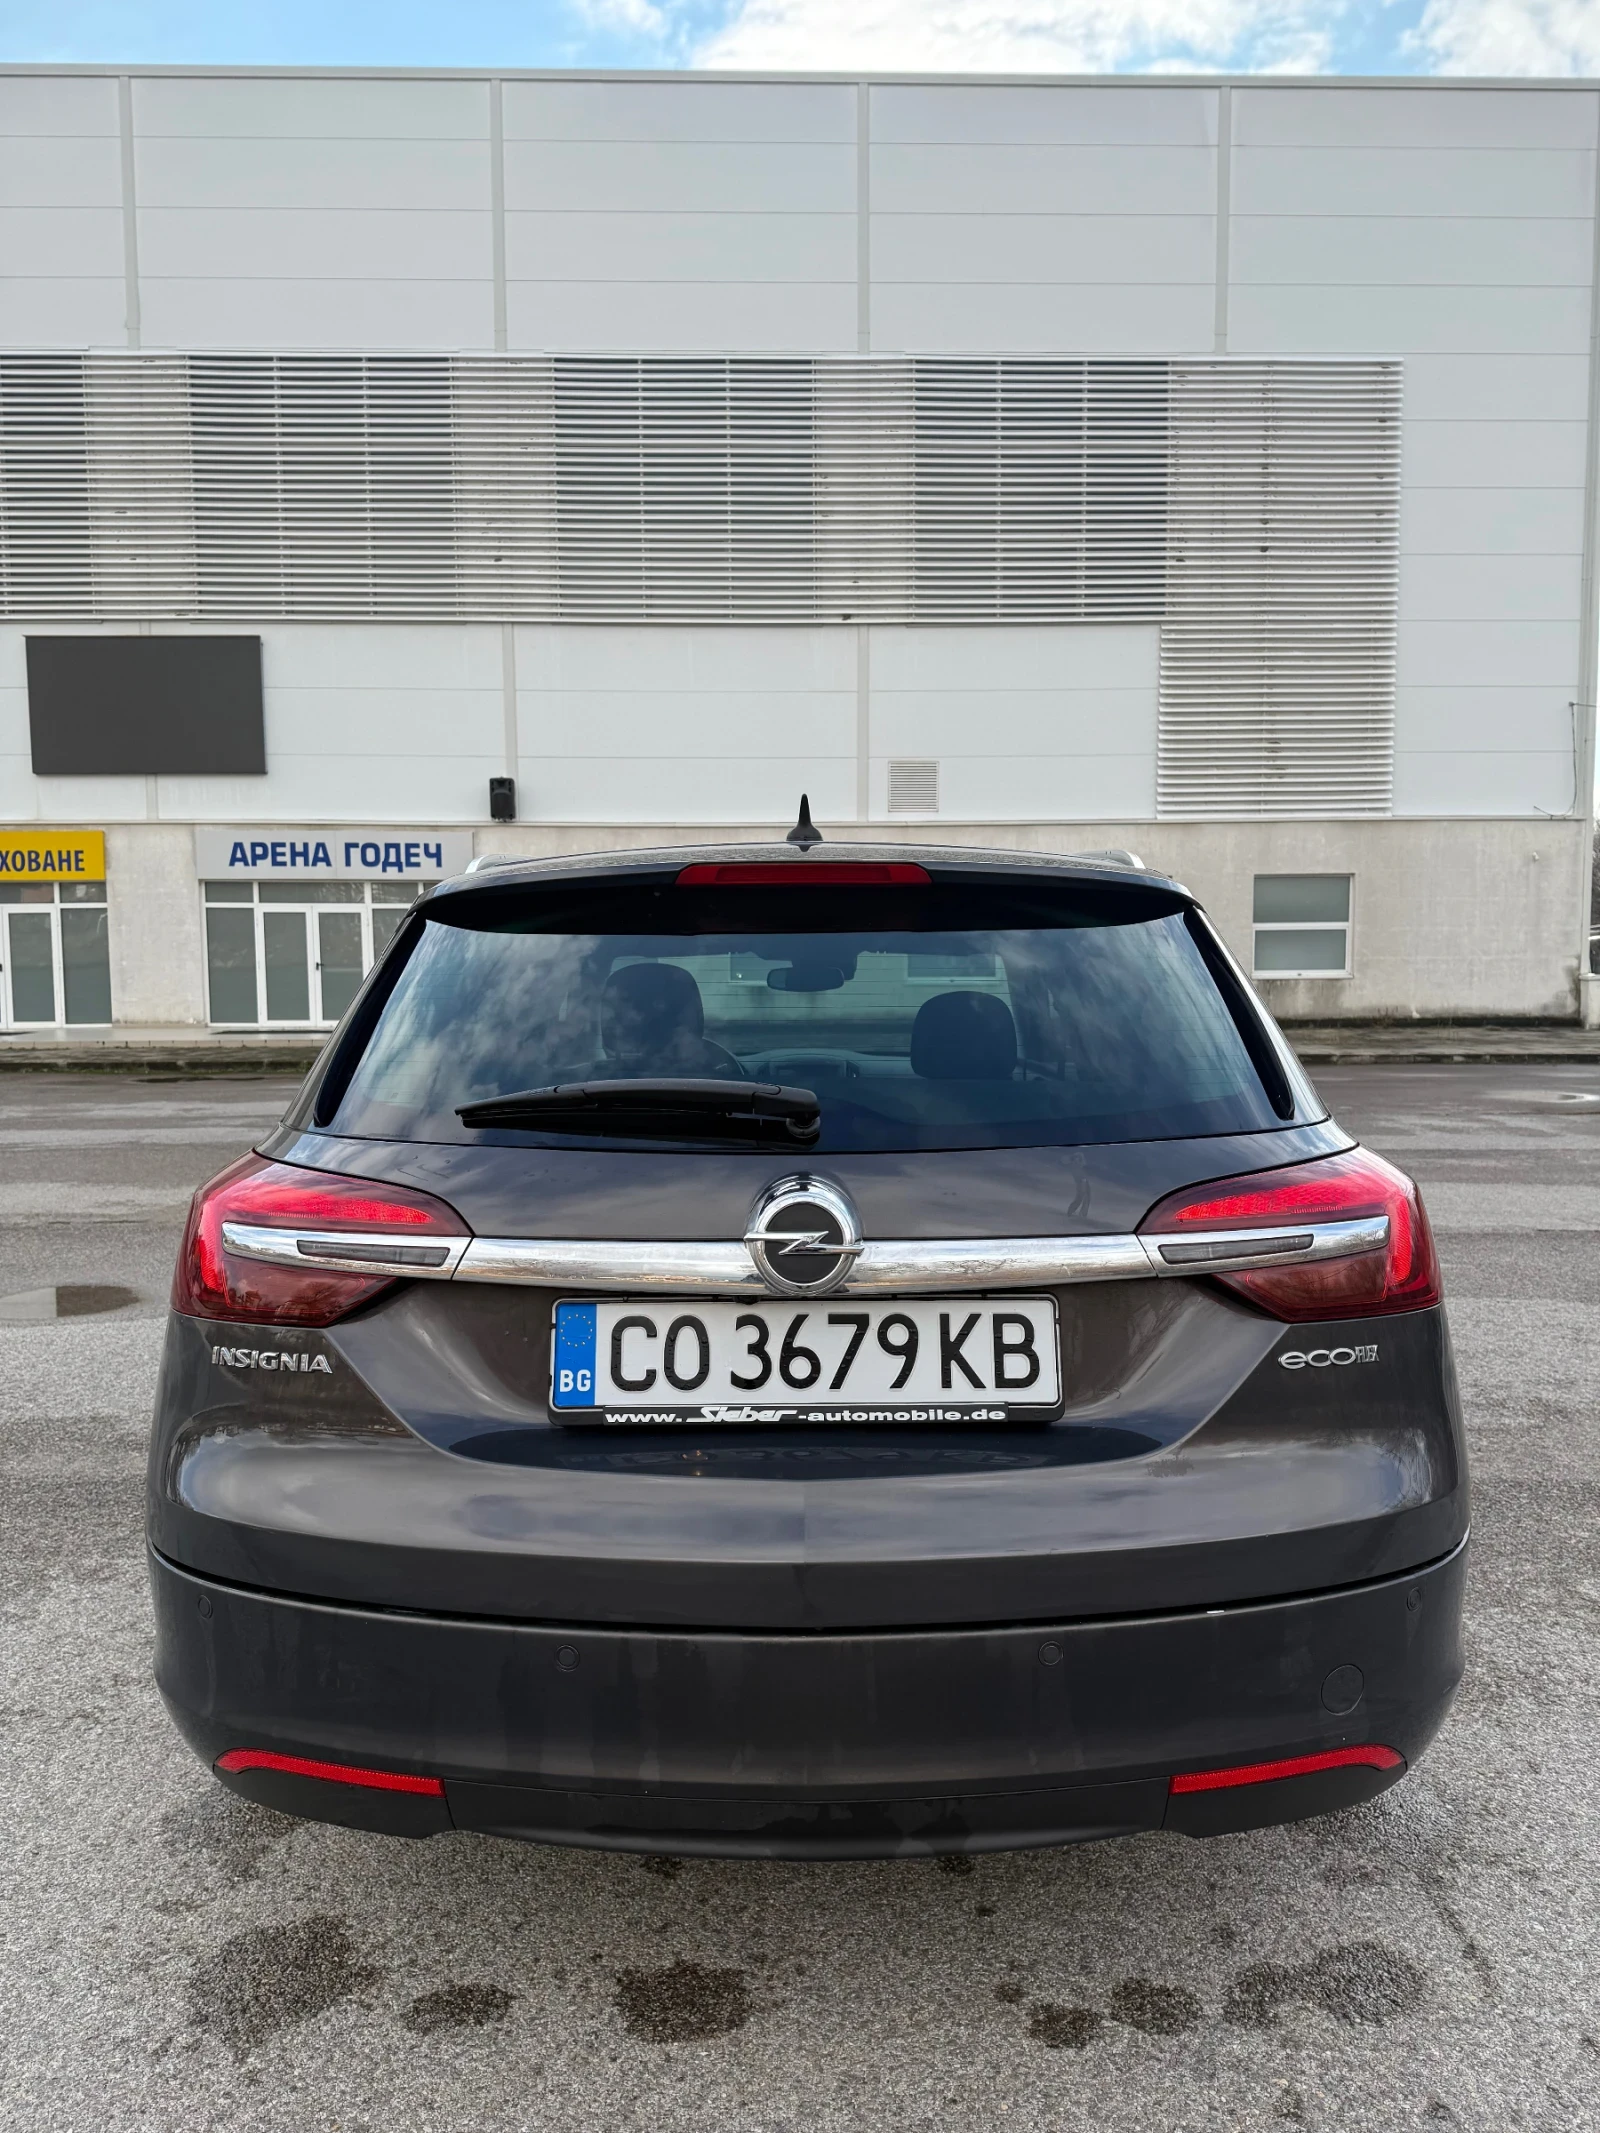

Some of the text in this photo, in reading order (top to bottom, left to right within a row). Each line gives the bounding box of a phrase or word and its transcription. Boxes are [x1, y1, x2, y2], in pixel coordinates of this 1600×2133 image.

[229, 841, 443, 873] АРЕНА ГОДЕЧ
[211, 1345, 333, 1374] INSIGNIA
[731, 1313, 919, 1391] 3679
[940, 1313, 1039, 1390] KB
[560, 1369, 591, 1392] BG
